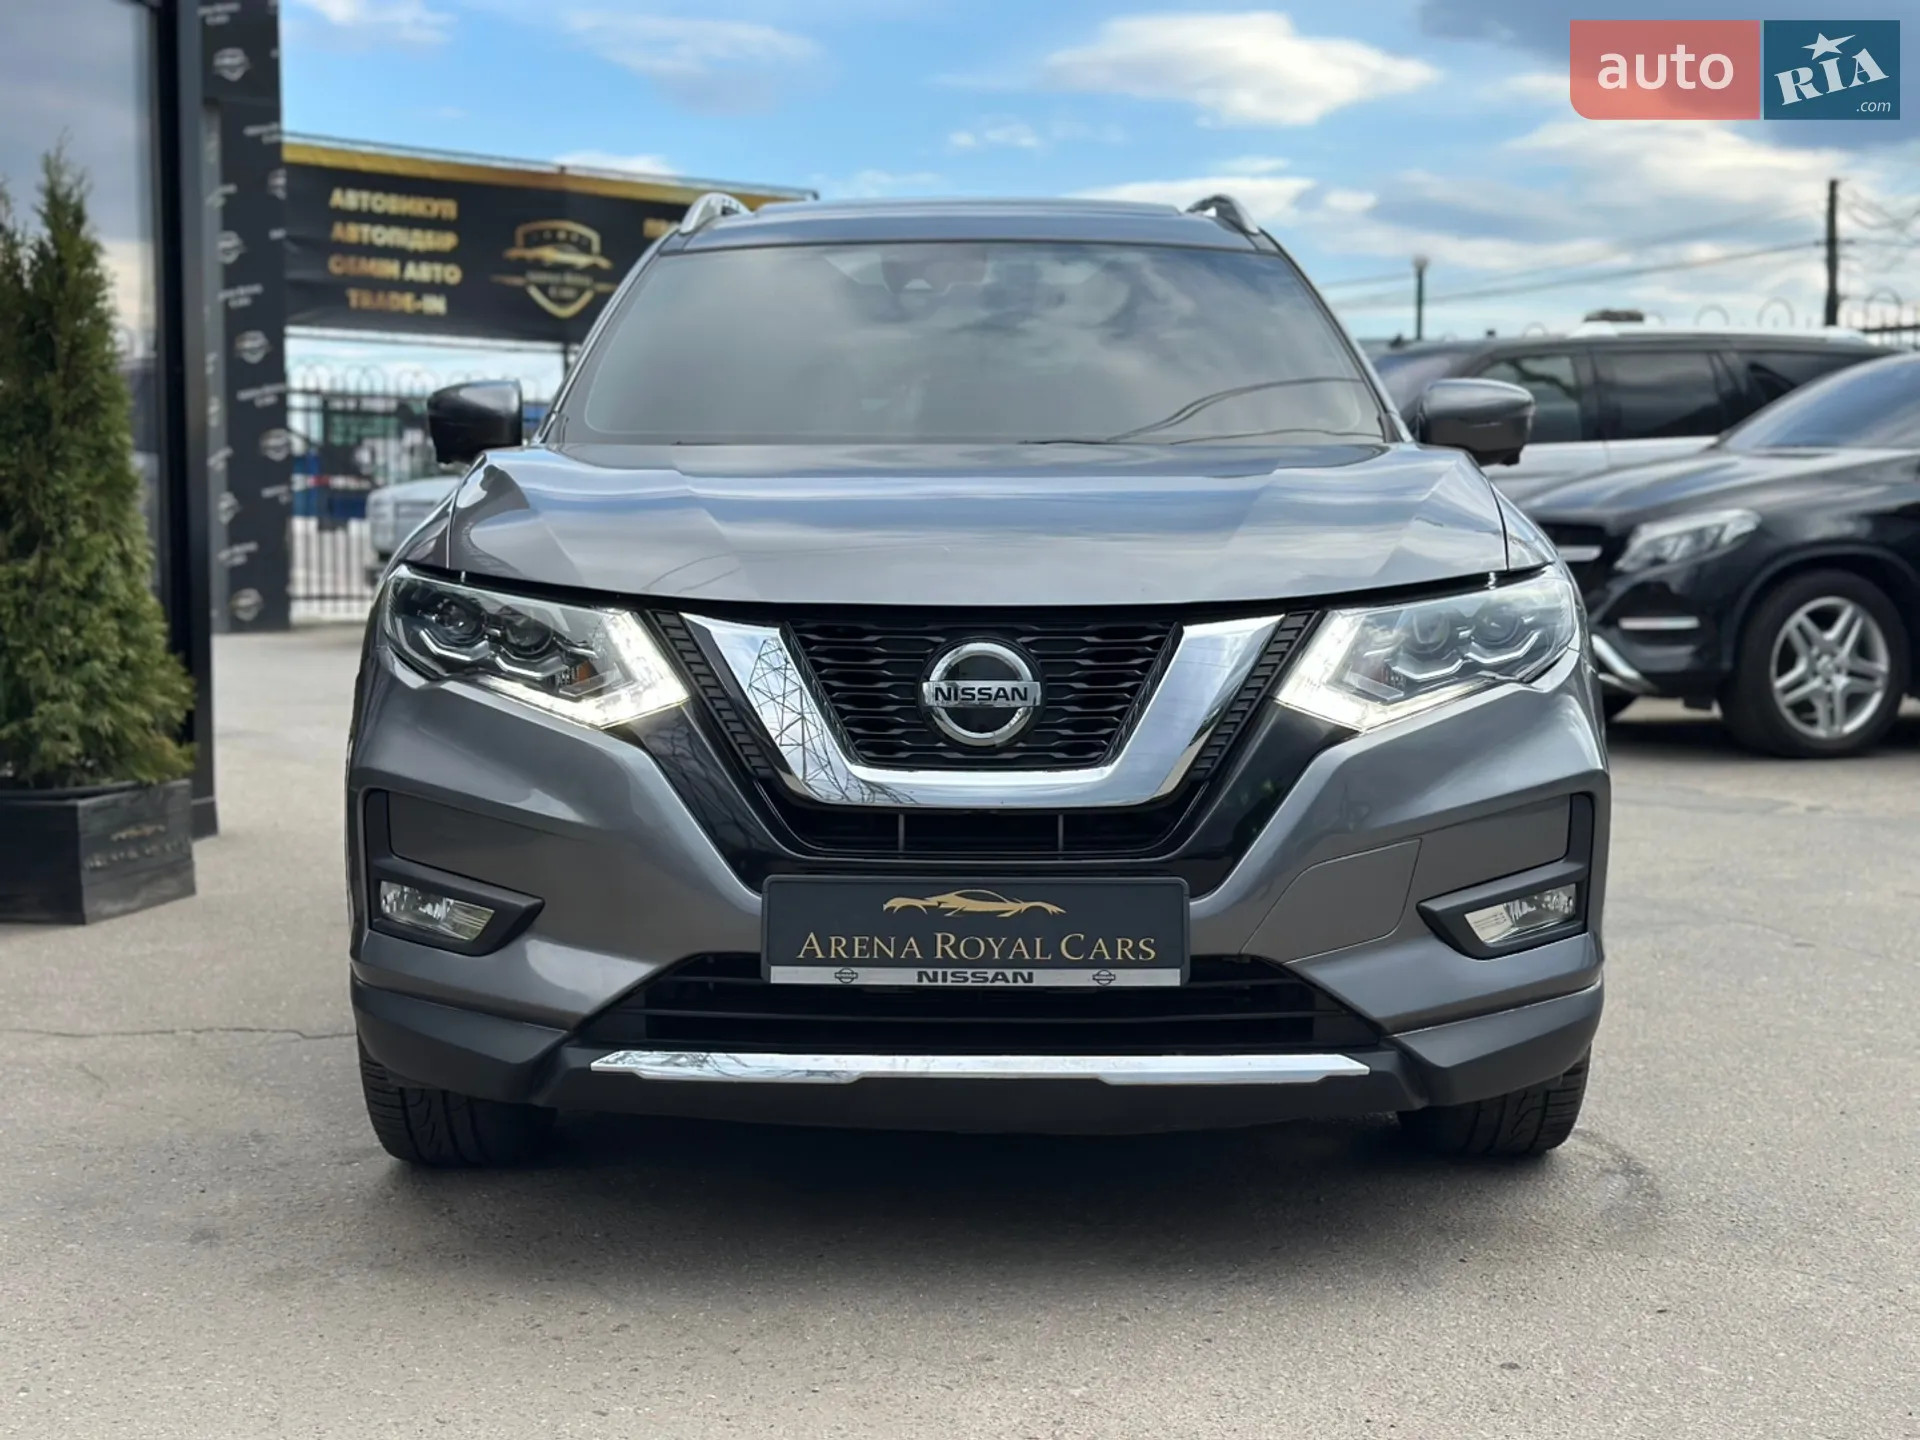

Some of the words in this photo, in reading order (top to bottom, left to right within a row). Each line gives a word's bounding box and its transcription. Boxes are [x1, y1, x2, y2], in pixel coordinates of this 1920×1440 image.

[403, 260, 462, 285] АВТО
[345, 288, 447, 315] TRADE-IN
[934, 686, 1028, 702] NISSAN
[796, 931, 924, 960] ARENA
[933, 932, 1052, 961] ROYAL
[1060, 933, 1156, 961] CARS
[917, 970, 1034, 984] NISSAN
